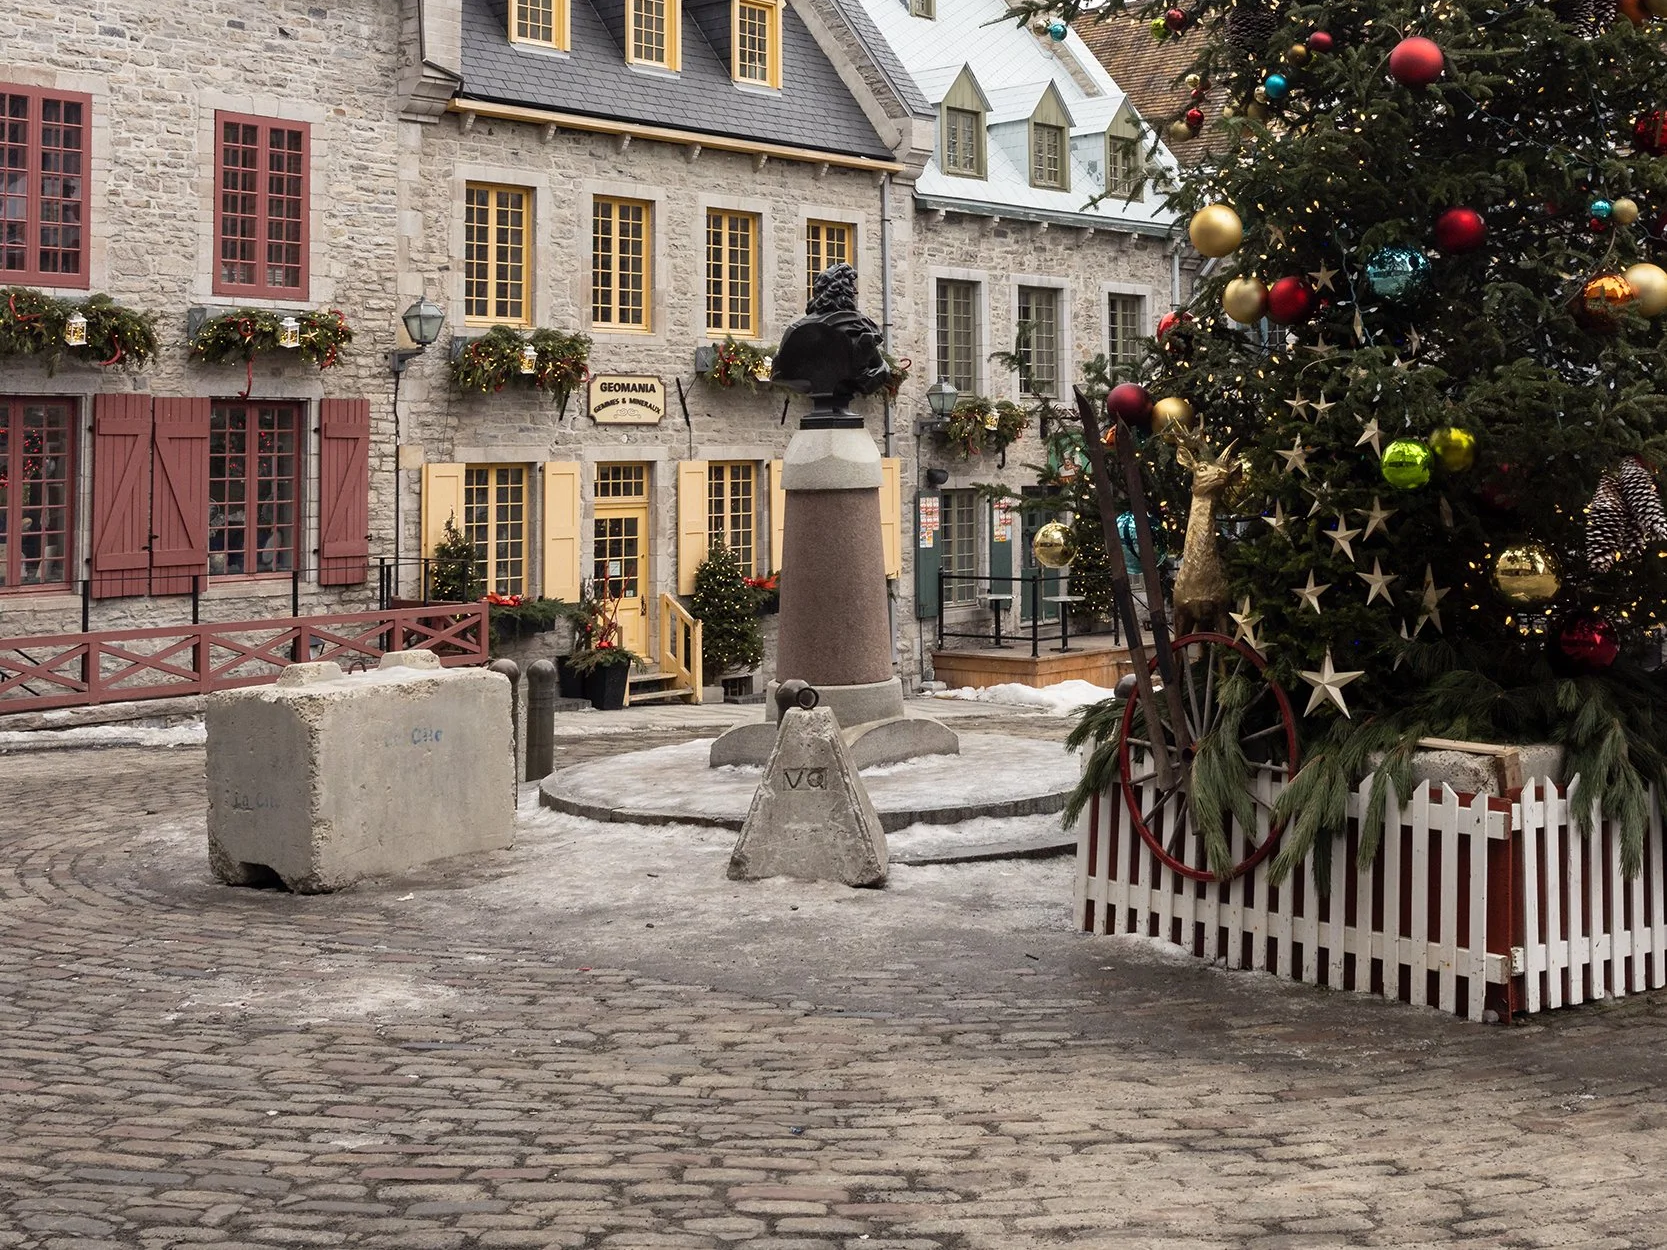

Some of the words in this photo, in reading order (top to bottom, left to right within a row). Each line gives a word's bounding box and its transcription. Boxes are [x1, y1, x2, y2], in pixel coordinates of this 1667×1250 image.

[600, 382, 656, 393] GEOMANIA
[594, 398, 620, 413] GEMMES
[629, 398, 661, 414] MINERAUX
